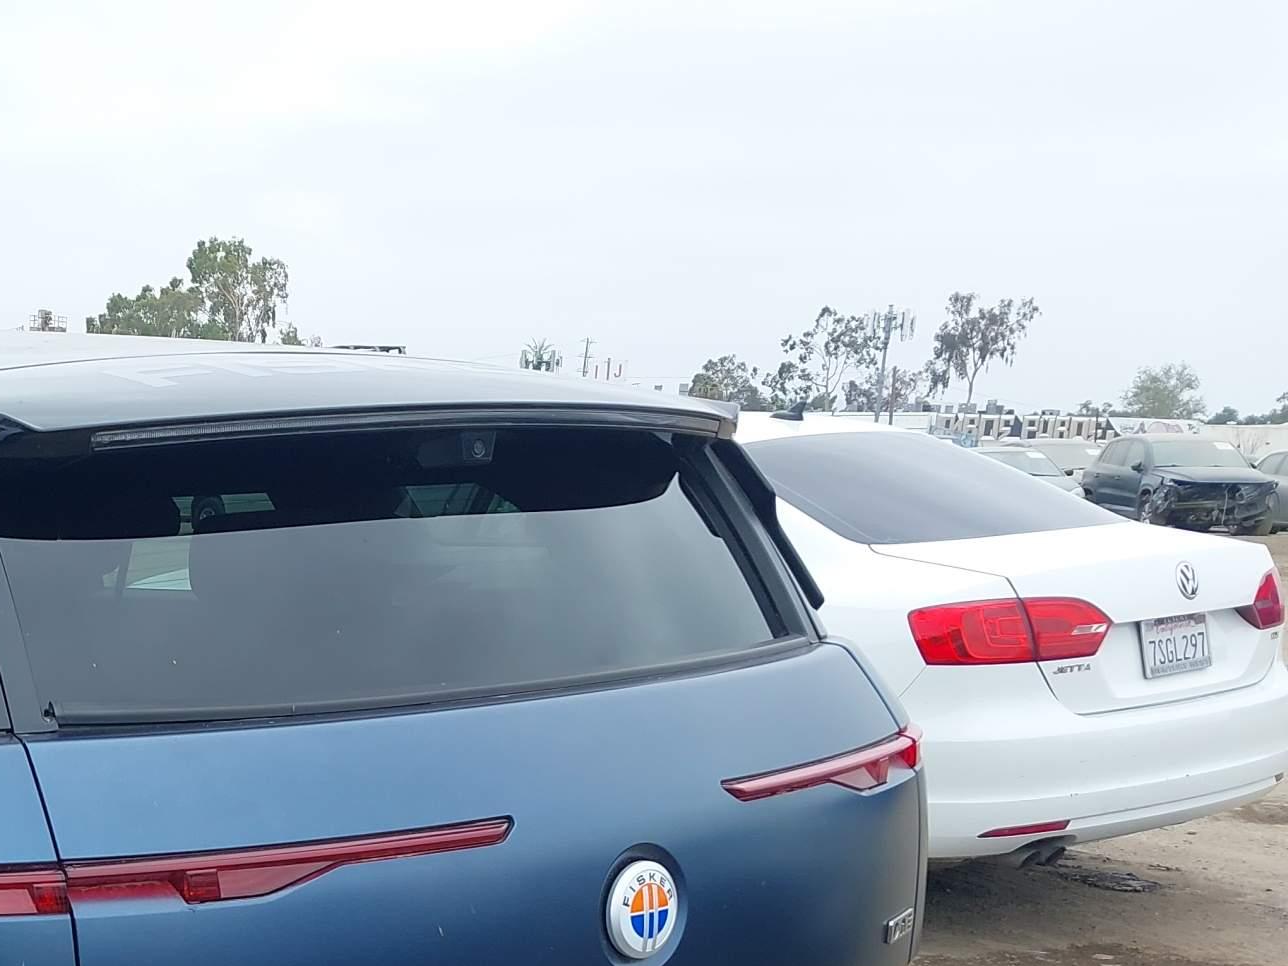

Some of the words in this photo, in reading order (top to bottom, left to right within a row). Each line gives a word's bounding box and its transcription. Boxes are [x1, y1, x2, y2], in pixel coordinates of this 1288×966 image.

[1148, 631, 1206, 667] 7SGL297
[1052, 662, 1091, 675] JETTA
[622, 872, 673, 908] FISKER
